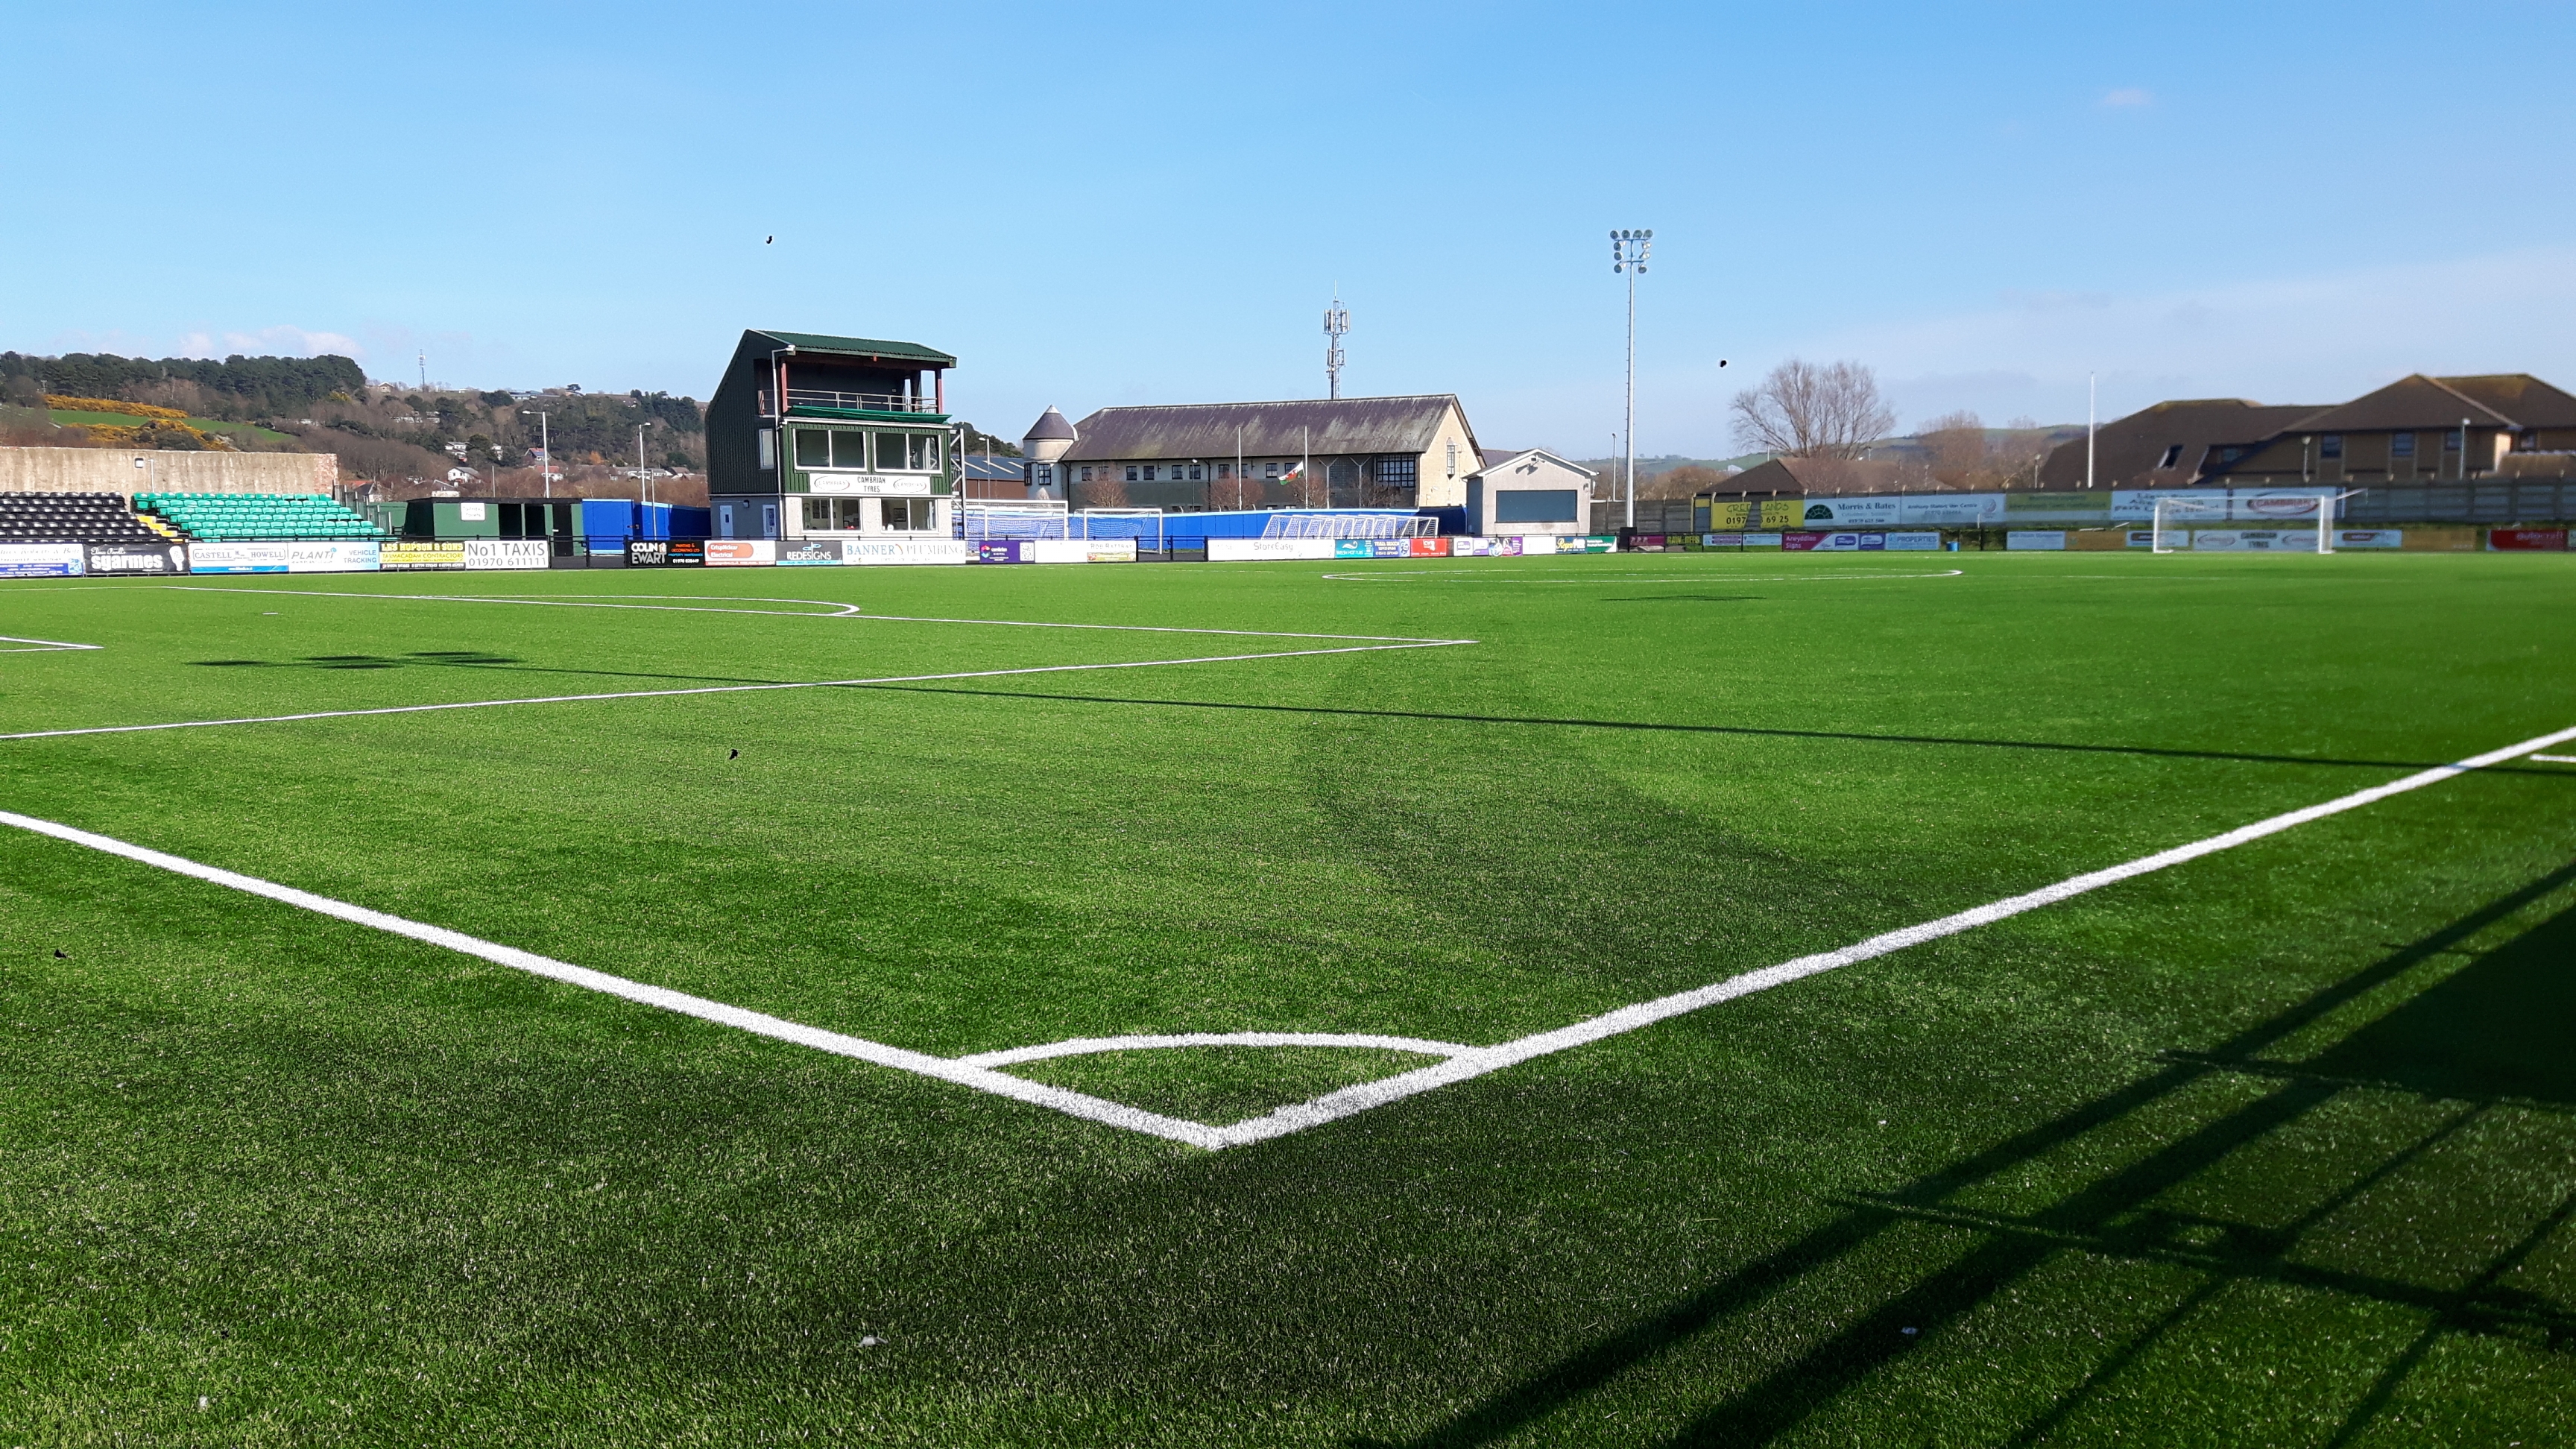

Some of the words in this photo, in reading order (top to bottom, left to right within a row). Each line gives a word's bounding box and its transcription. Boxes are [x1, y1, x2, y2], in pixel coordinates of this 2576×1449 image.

[857, 476, 886, 484] CAMBRIAN
[1875, 502, 1896, 510] Bates
[1779, 515, 1789, 523] 25
[381, 543, 398, 552] LES
[400, 543, 432, 551] HOPSON
[434, 543, 441, 551] &
[441, 542, 464, 551] SONS
[468, 543, 496, 556] No1
[502, 543, 545, 556] TAXIS
[631, 542, 658, 552] COLIN
[846, 544, 896, 555] BANNER
[906, 544, 963, 555] PLUMBING
[631, 552, 666, 564] EWART
[786, 549, 832, 561] REDESIGNS
[90, 555, 163, 571] sgarmes
[469, 558, 503, 566] 01970
[508, 558, 546, 566] 611111
